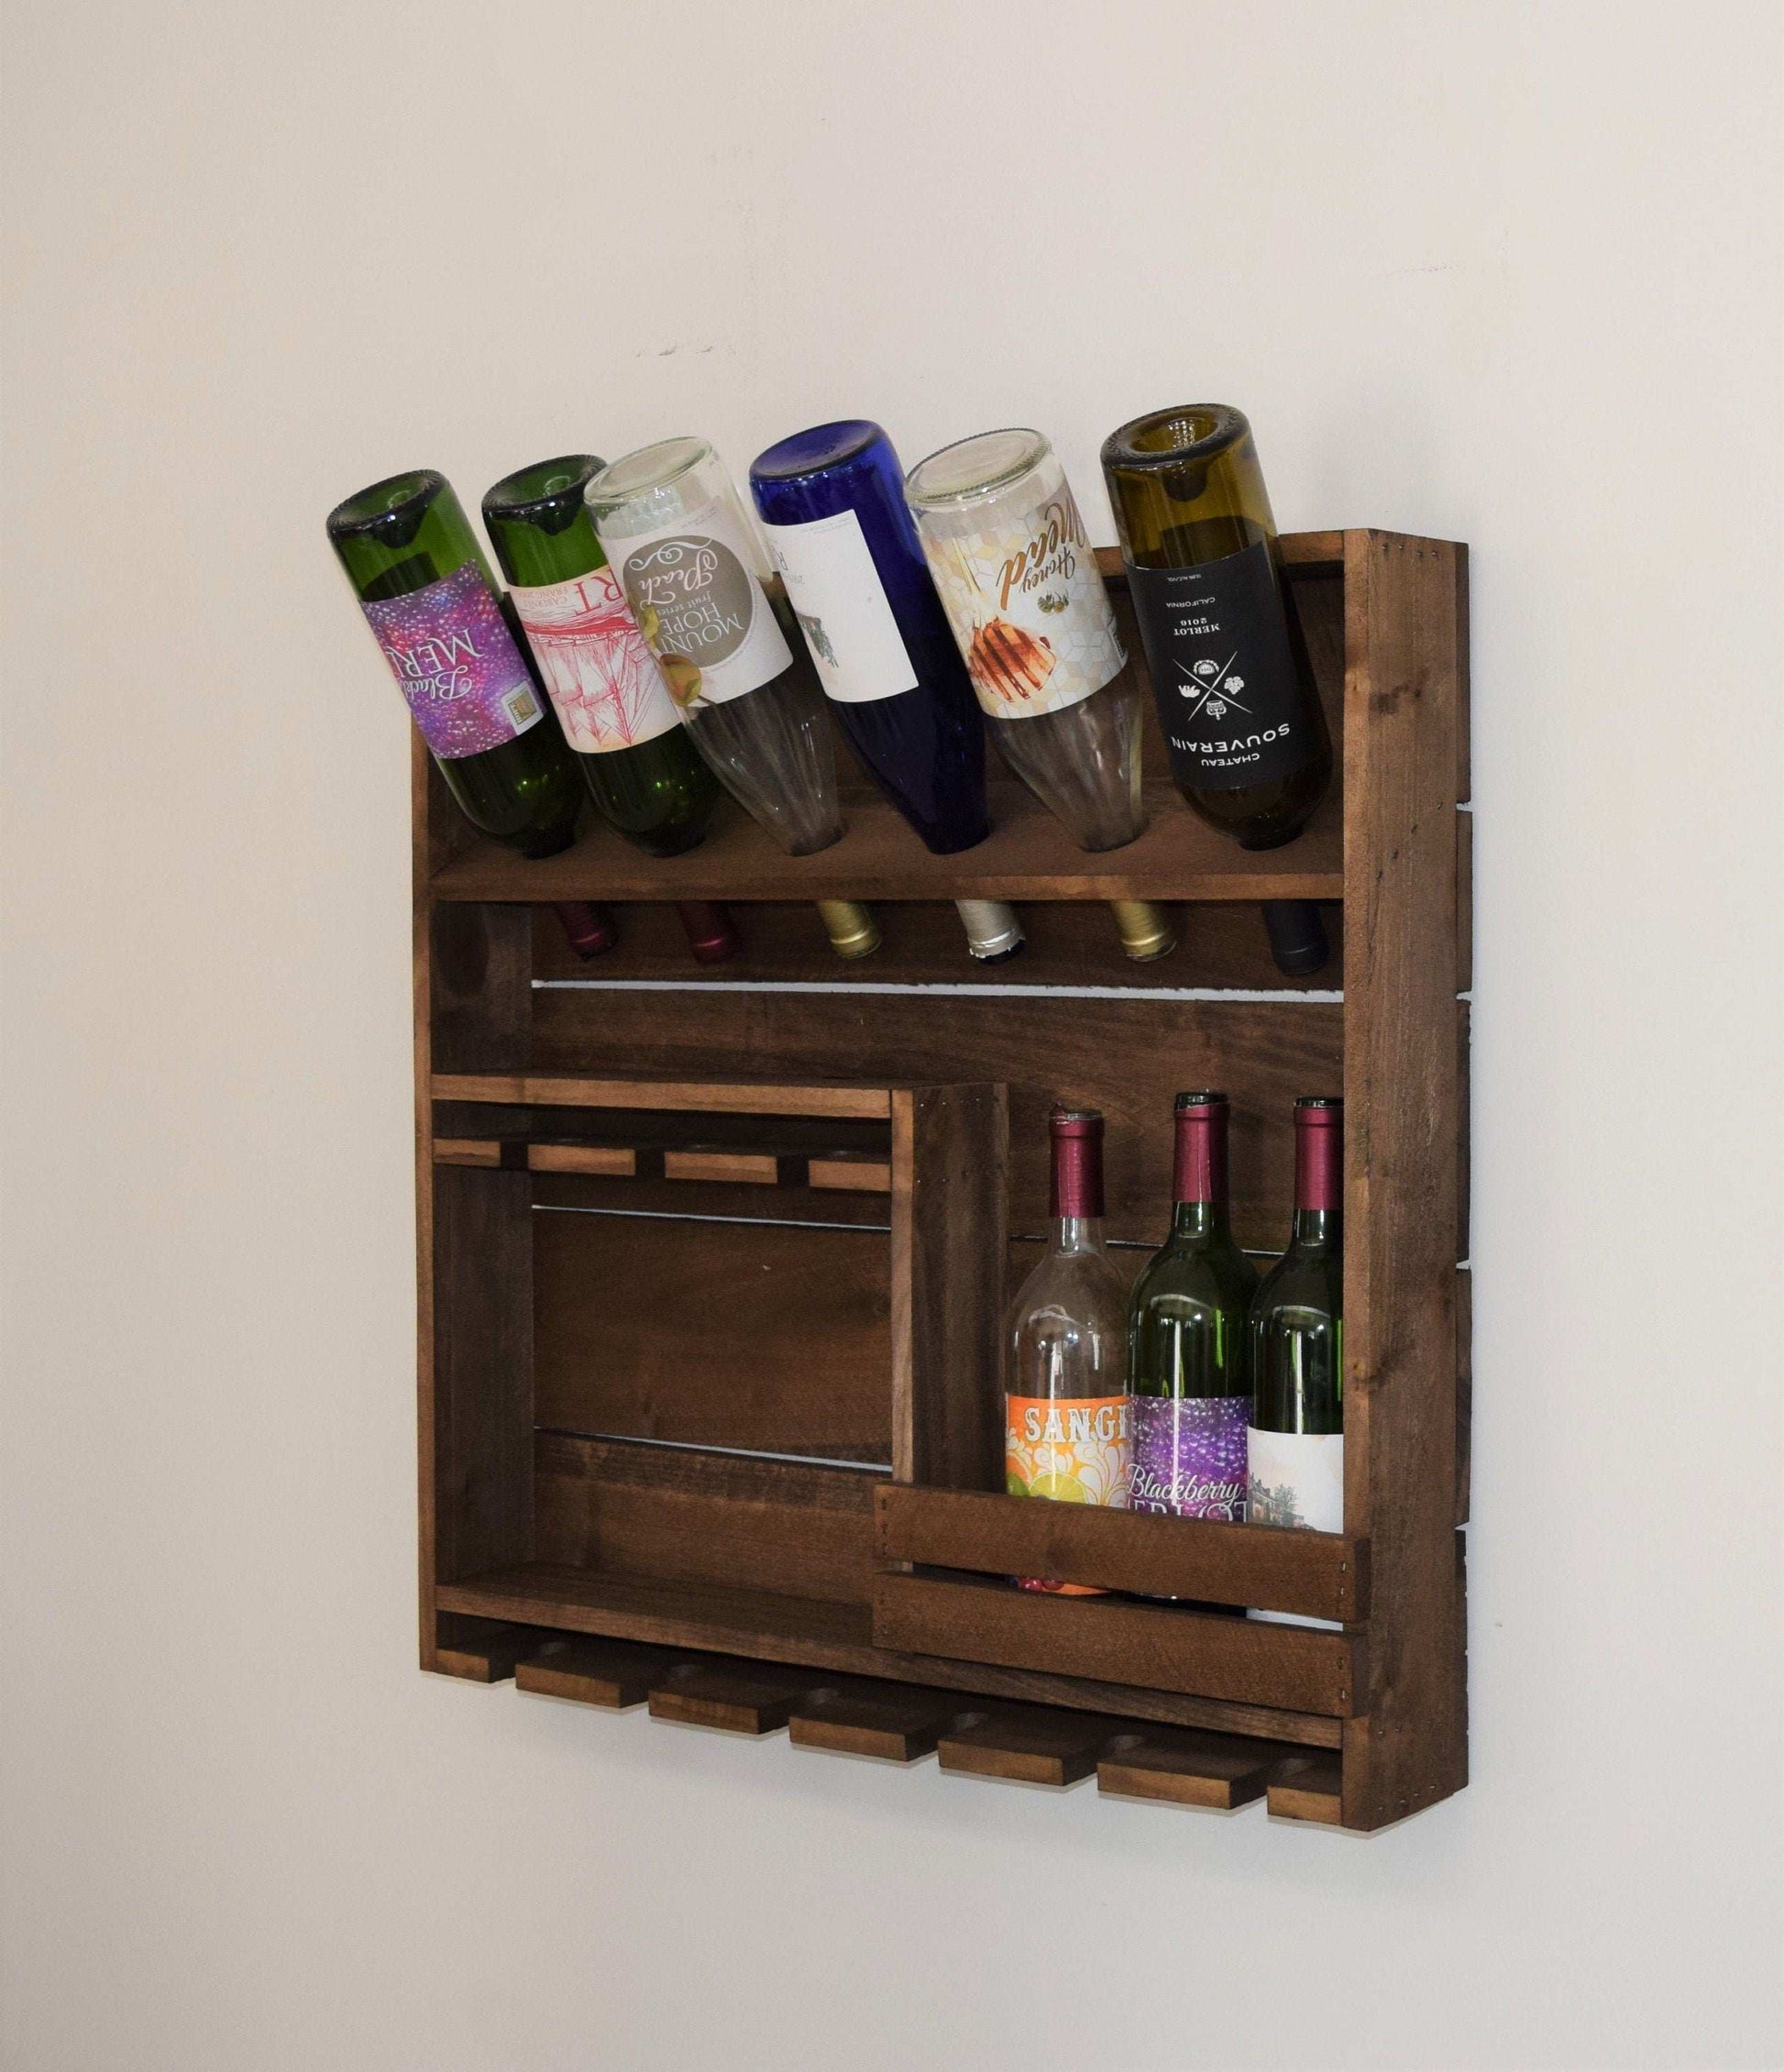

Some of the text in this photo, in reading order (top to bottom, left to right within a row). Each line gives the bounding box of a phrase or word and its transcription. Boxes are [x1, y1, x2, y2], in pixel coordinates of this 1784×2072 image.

[996, 498, 1086, 611] Mead
[638, 548, 718, 611] Peach
[1019, 547, 1076, 595] Honey
[655, 590, 711, 616] fruit series
[659, 601, 722, 635] HOPE
[1165, 597, 1216, 608] CALIFORNIA
[659, 613, 744, 655] MOUNT
[1173, 623, 1221, 636] MERLOT
[1180, 617, 1207, 627] 2016
[1171, 722, 1291, 753] SOUVERAIN
[1201, 753, 1261, 767] CHATEAU
[1125, 1463, 1245, 1507] Blackberry
